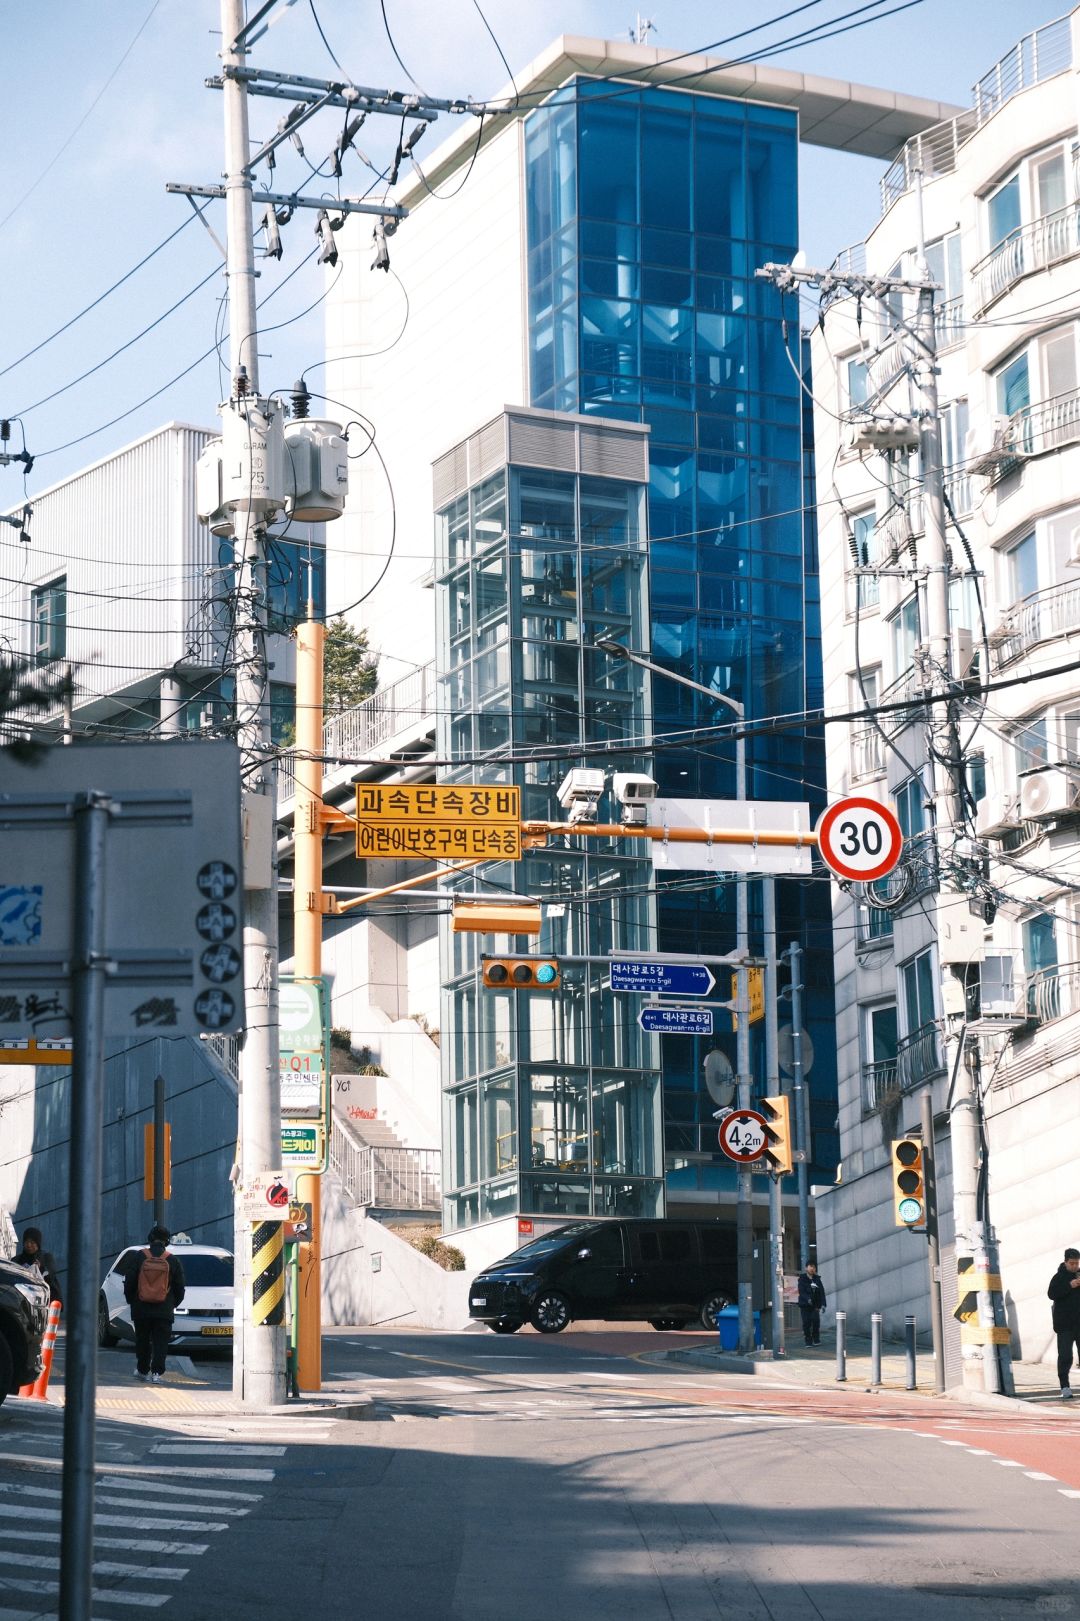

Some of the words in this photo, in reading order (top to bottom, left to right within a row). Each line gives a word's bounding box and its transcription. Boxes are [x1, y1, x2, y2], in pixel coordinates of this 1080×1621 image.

[361, 789, 517, 816] 과속단속장비
[361, 827, 467, 852] 어린이보호구역
[472, 829, 517, 854] 단속중
[839, 820, 883, 857] 30
[613, 964, 664, 977] 대사관로5길
[613, 975, 656, 984] Daesagwan-ro
[657, 976, 672, 985] 5-gil
[662, 1013, 710, 1024] 대사관로6길
[650, 1023, 695, 1032] Daesagwan-ro
[695, 1025, 710, 1033] 6-gil
[728, 1126, 761, 1146] 4.2m
